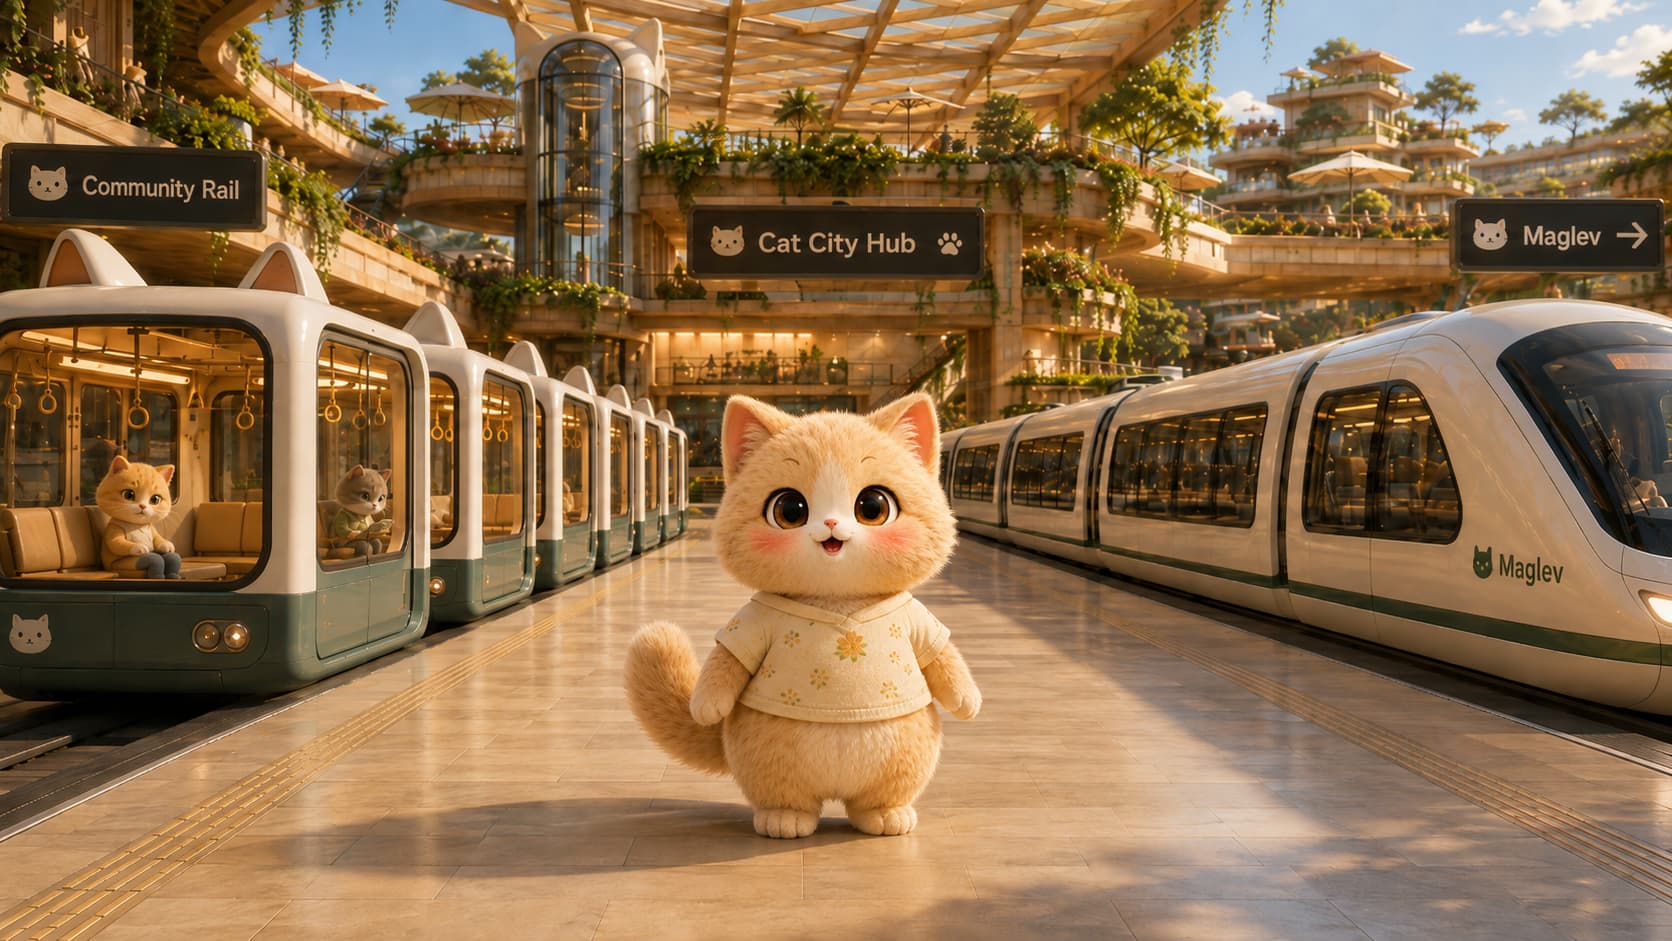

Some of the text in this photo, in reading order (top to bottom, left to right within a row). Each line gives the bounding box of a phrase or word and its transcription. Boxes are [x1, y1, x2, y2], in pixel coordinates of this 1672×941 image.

[82, 175, 239, 203] Community Rail
[758, 232, 916, 258] Cat City Hub
[1523, 225, 1601, 251] Maglev
[1499, 553, 1564, 587] Maglev
